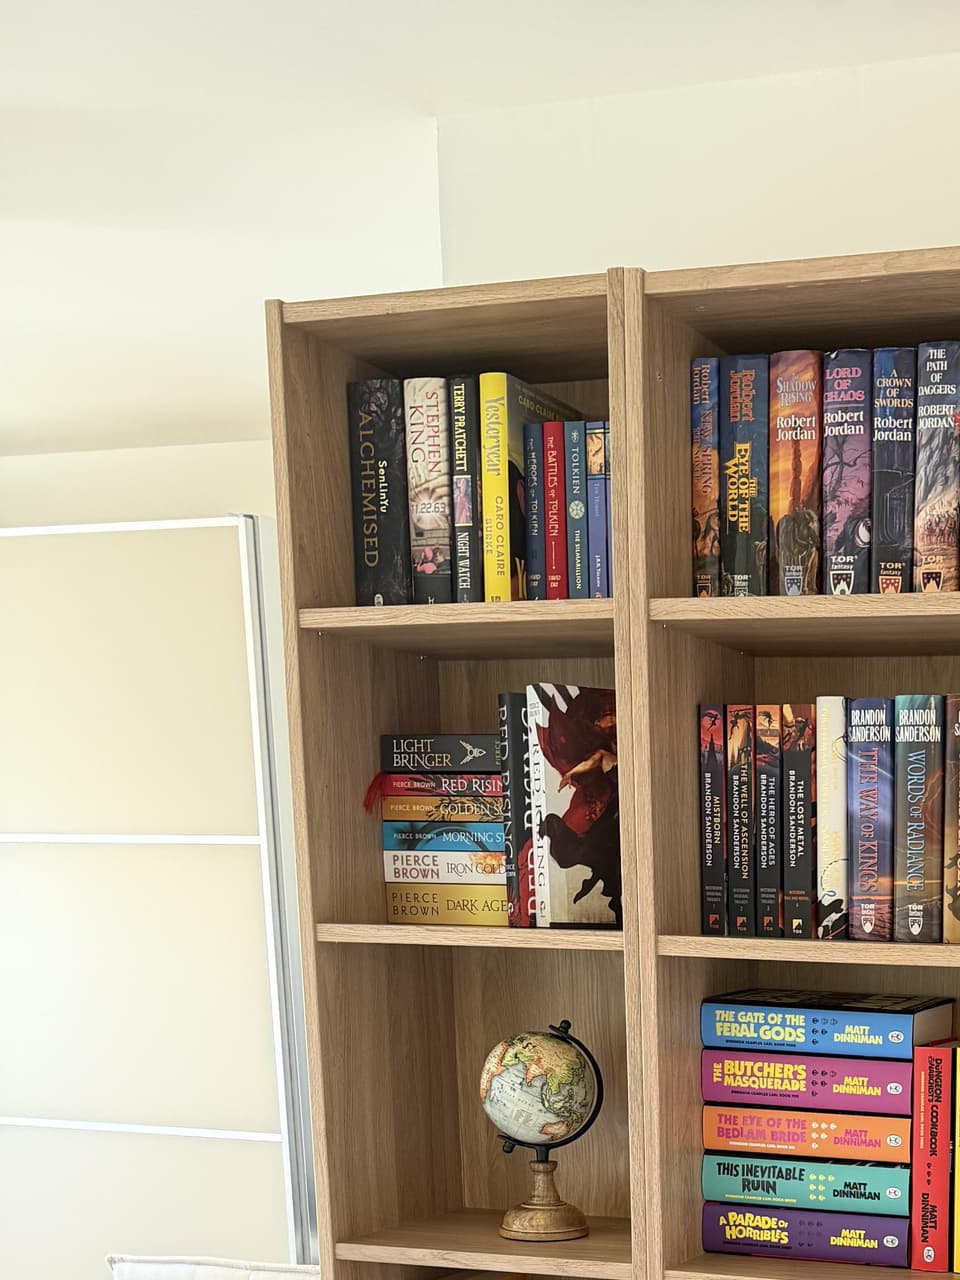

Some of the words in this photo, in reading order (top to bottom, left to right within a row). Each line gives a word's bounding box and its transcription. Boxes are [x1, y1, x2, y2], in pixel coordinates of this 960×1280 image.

[825, 368, 861, 379] LORD
[834, 379, 852, 390] OF
[876, 378, 912, 388] CROWN
[874, 399, 914, 408] SWORDS
[874, 416, 912, 429] Robert
[409, 405, 425, 464] KING
[426, 391, 441, 474] STEPHEN
[485, 396, 501, 477] Yesteryear
[776, 428, 816, 441] Jordan
[358, 411, 379, 567] ALCHEMISED
[851, 710, 886, 725] BRANDON
[393, 739, 434, 753] LIGHT
[393, 754, 451, 770] BRINGER
[392, 856, 439, 865] PIERCE
[394, 868, 439, 879] BROWN
[392, 893, 438, 902] PIERCE
[392, 905, 439, 916] BROWN
[715, 1024, 757, 1038] FERAL
[759, 1026, 805, 1042] GODS
[845, 1025, 869, 1035] MATT
[834, 1033, 883, 1045] DINNIMAN
[724, 1060, 806, 1080] BUTCHER'S
[724, 1077, 806, 1091] MASQUERADE
[833, 1084, 881, 1096] DINNIMAN
[834, 1136, 881, 1148] DINNIMAN
[716, 1163, 739, 1178] THIS
[742, 1163, 805, 1181] INEVITABLE
[742, 1179, 777, 1195] RUIN
[725, 1227, 789, 1244] HORRIBLES
